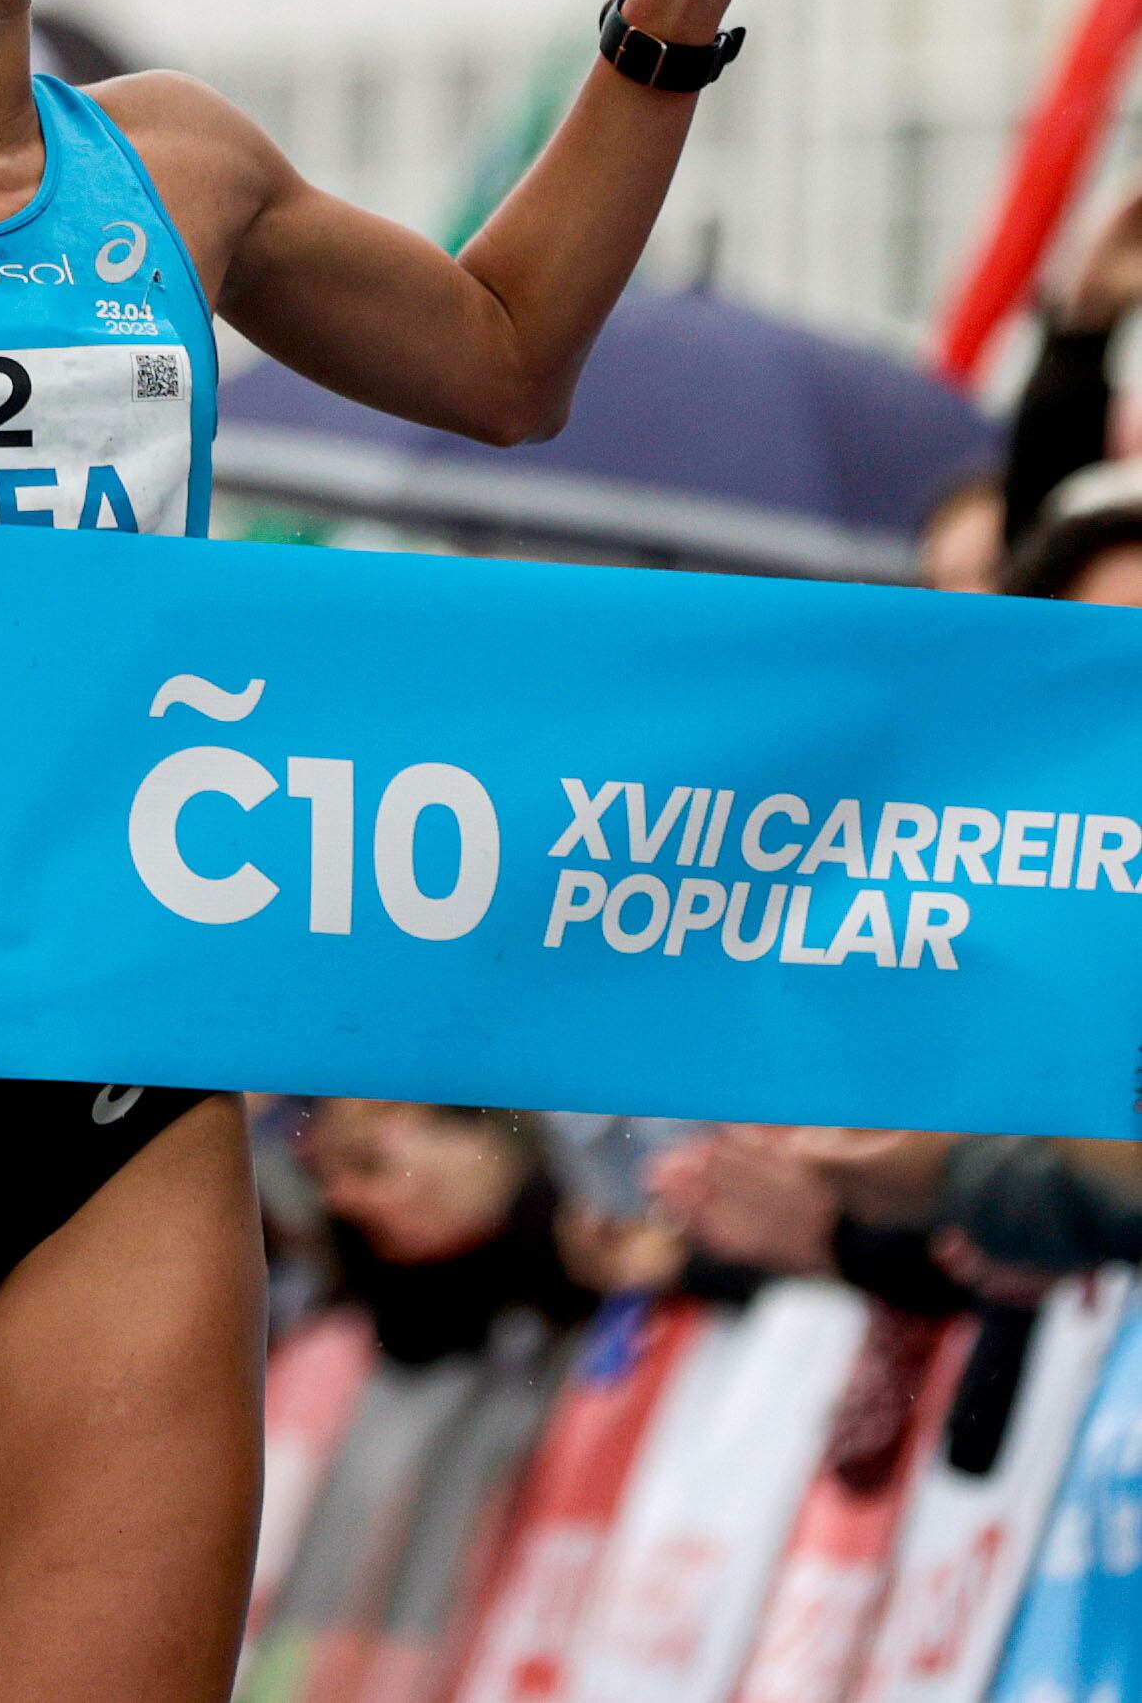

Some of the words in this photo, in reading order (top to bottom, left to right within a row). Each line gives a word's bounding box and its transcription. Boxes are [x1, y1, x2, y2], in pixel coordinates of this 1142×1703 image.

[95, 299, 155, 322] 23.04
[105, 319, 159, 336] 2023
[548, 777, 735, 869] XVII
[741, 793, 1142, 894] CARREIR
[543, 869, 972, 971] POPULAR
